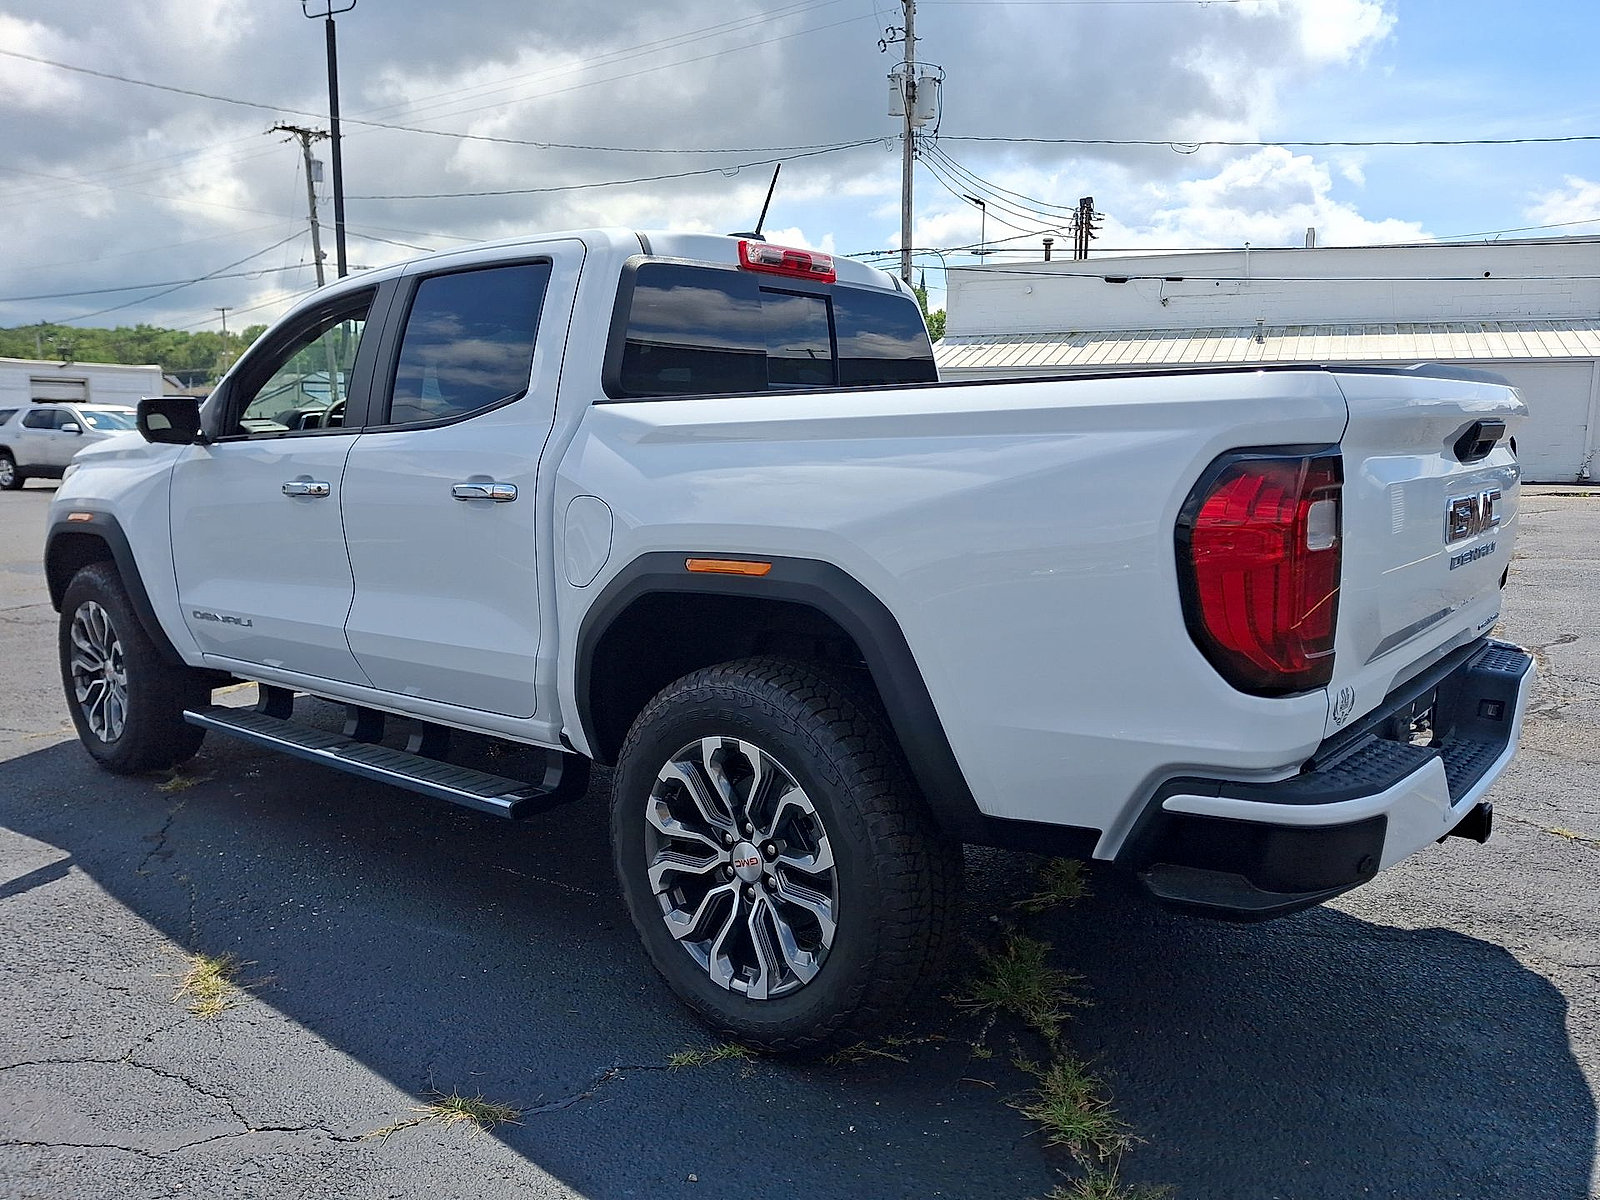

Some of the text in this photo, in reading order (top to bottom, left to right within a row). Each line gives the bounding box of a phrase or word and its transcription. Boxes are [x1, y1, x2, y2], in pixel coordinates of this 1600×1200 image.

[1446, 489, 1501, 543] GMC
[192, 611, 253, 627] DENALI
[735, 857, 759, 867] GMC
